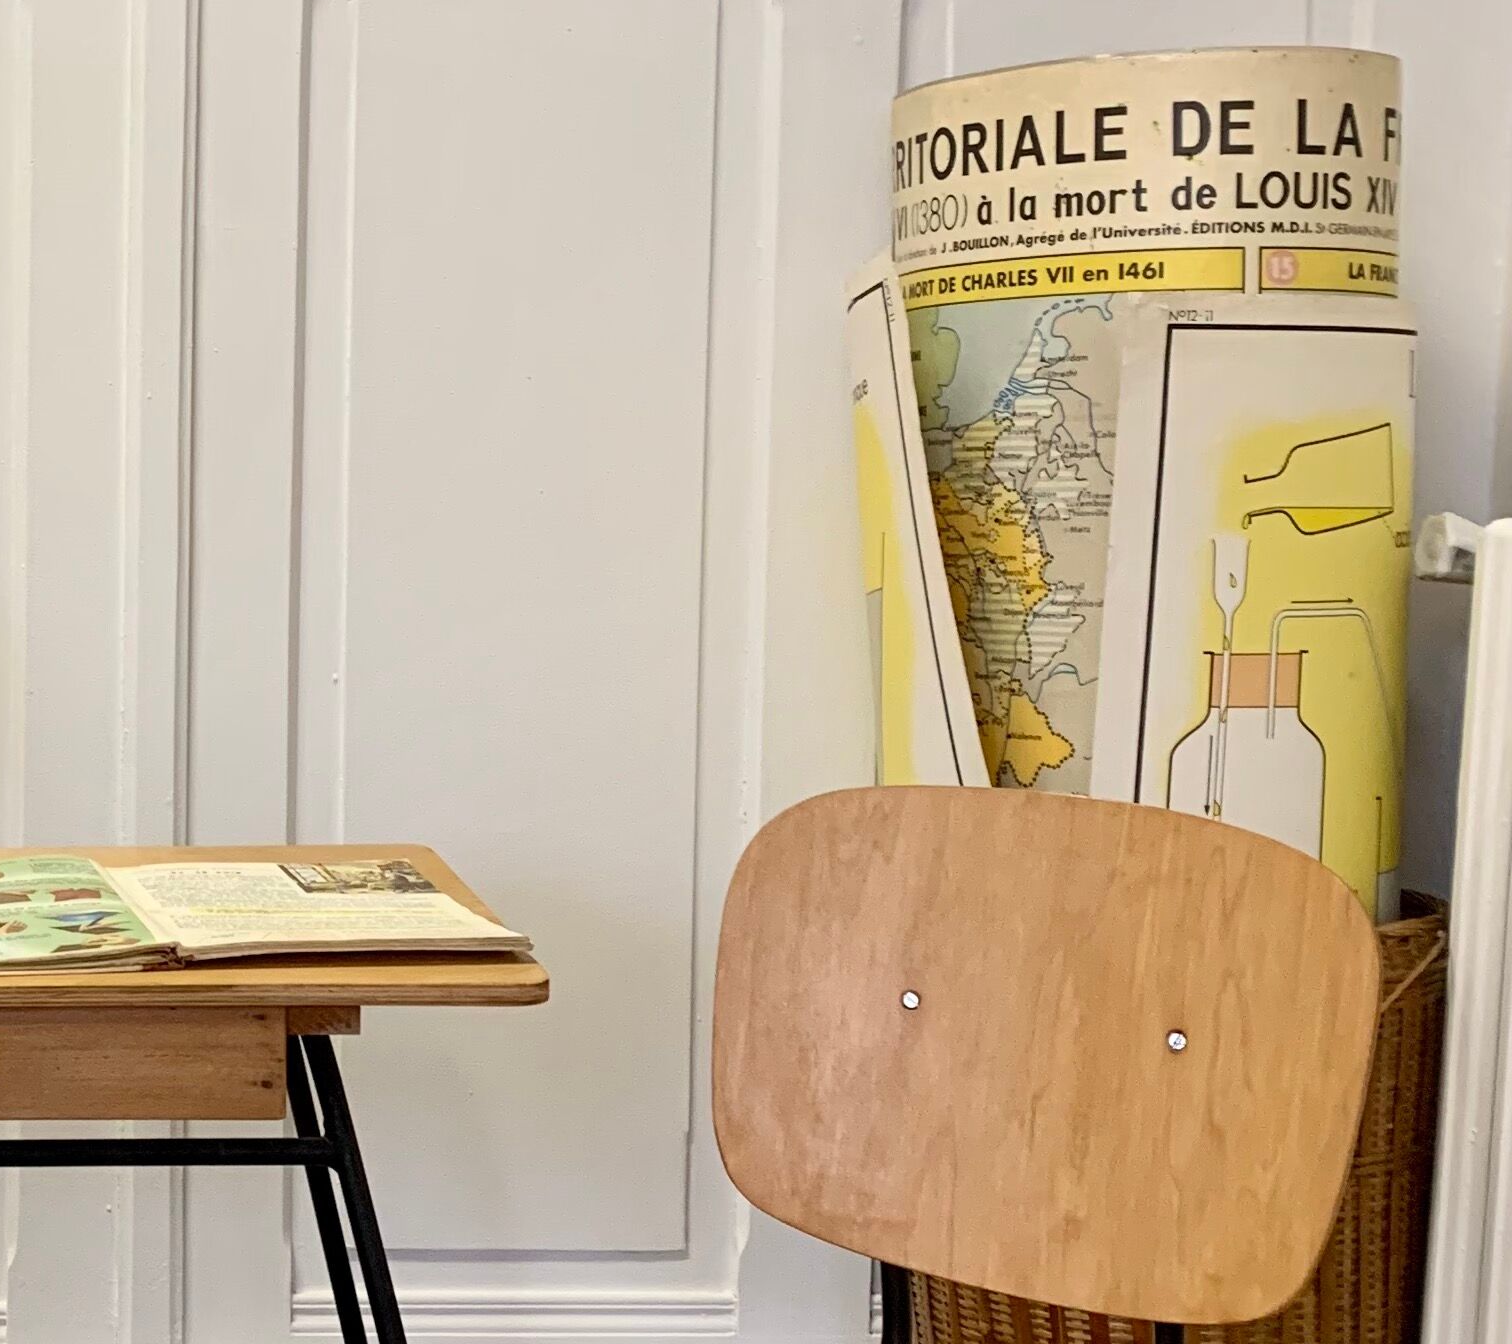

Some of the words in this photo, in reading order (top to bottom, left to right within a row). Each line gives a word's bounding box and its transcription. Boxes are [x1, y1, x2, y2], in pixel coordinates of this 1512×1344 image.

[892, 106, 1128, 193] RITORIALE
[1172, 100, 1255, 157] DE
[1297, 99, 1363, 158] LA
[977, 194, 993, 226] à
[1008, 186, 1037, 223] la
[1054, 179, 1148, 219] mort
[1171, 176, 1217, 211] de
[1235, 171, 1353, 211] LOUIS
[1070, 228, 1087, 241] de
[1191, 219, 1266, 235] ÉDITIONS
[908, 279, 934, 299] MORT
[938, 276, 956, 294] DE
[961, 269, 1038, 291] CHARLES
[1046, 266, 1074, 283] VII
[1082, 267, 1109, 282] en
[1118, 261, 1165, 281] 1461
[1269, 255, 1295, 281] 15
[1349, 262, 1365, 280] LA
